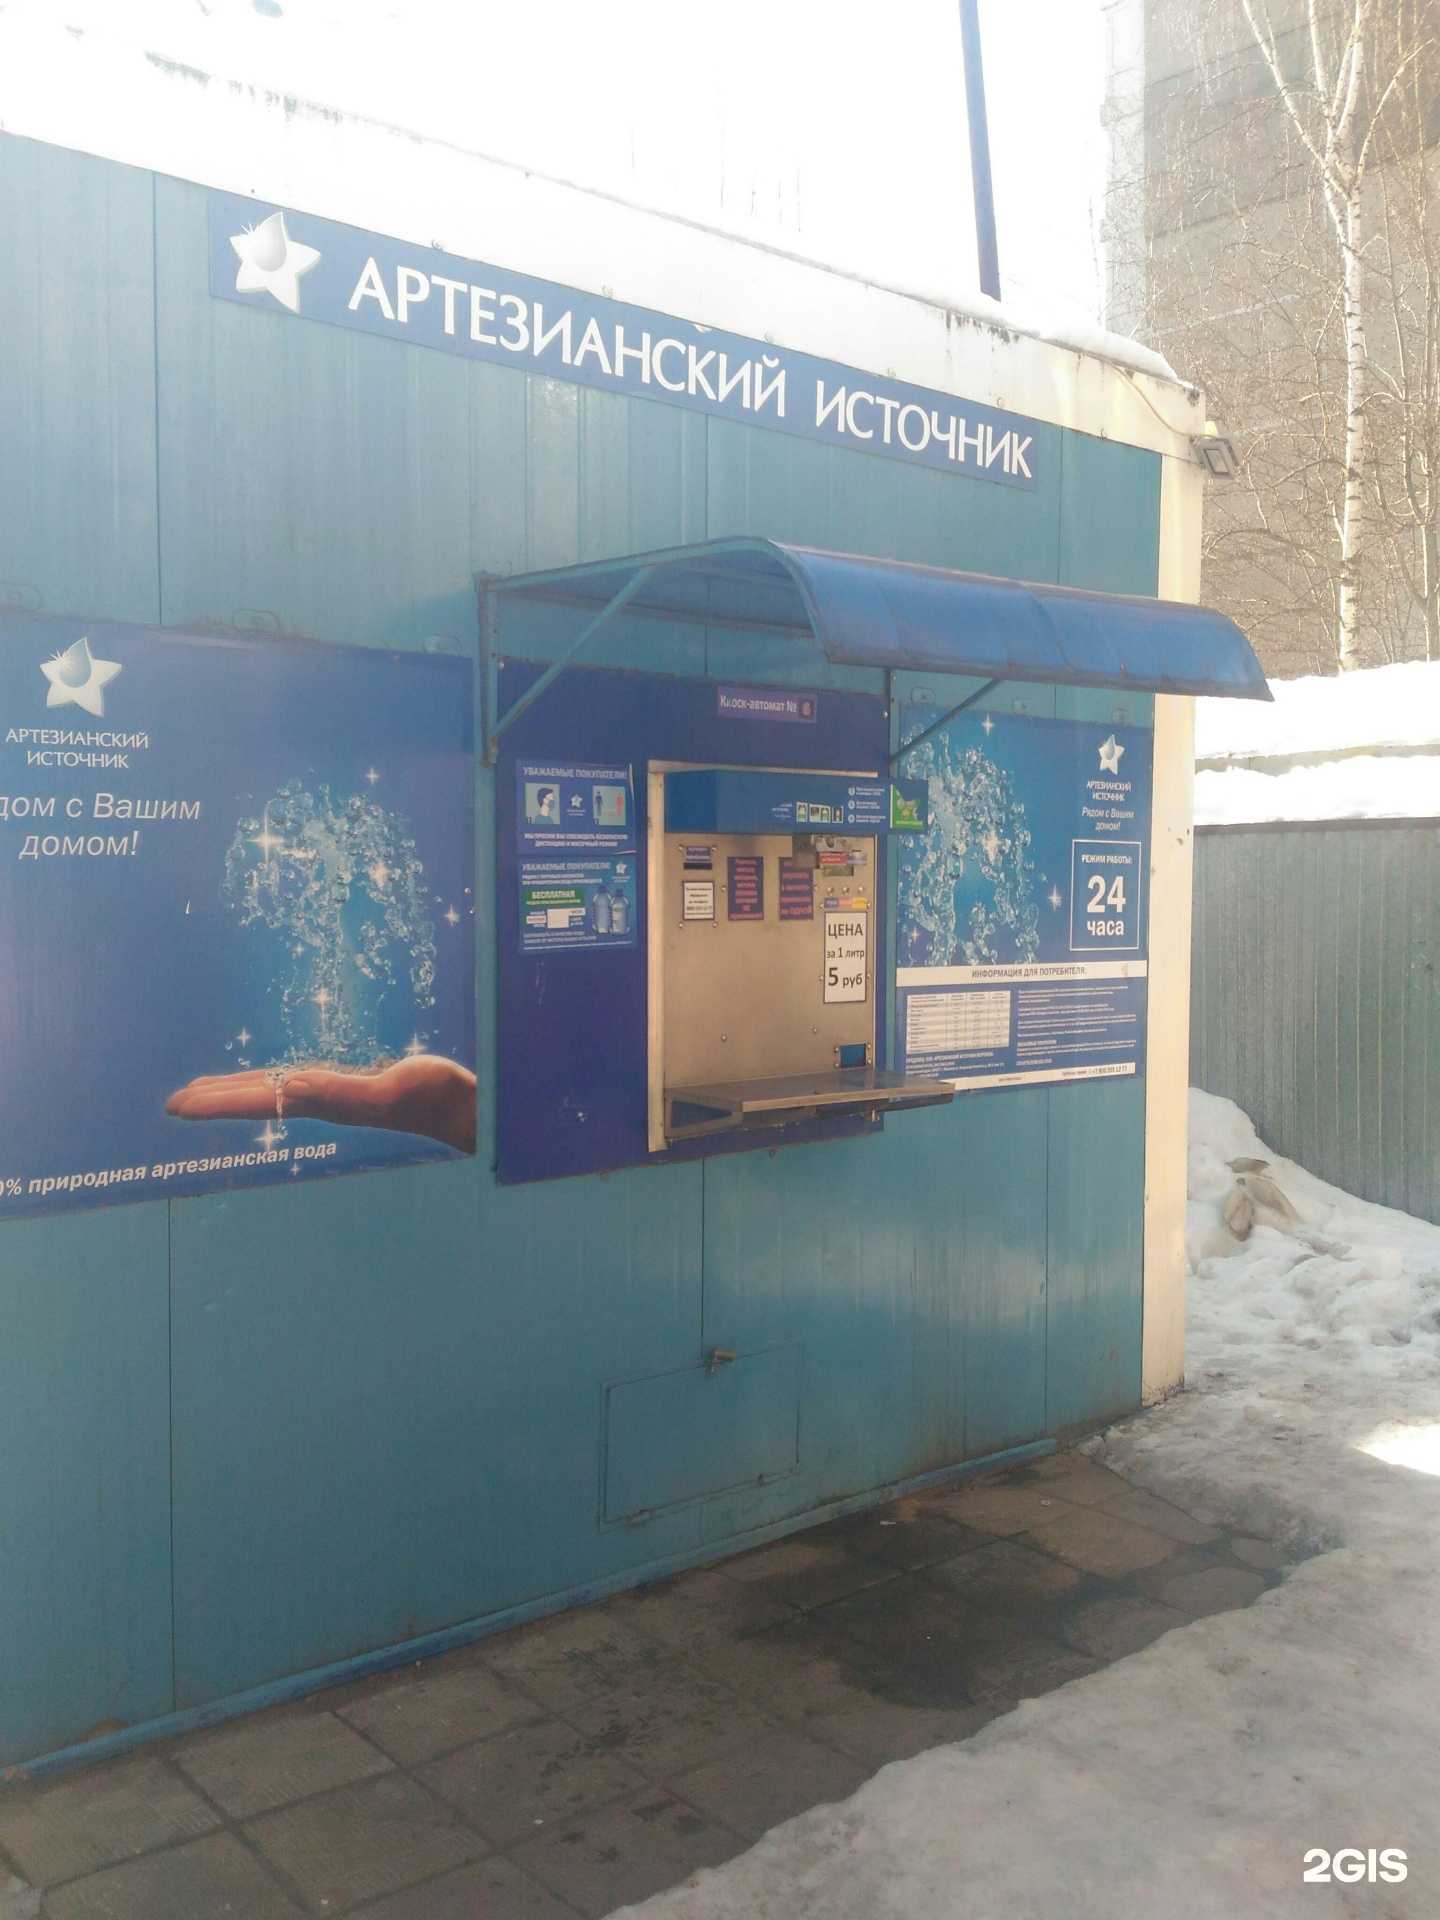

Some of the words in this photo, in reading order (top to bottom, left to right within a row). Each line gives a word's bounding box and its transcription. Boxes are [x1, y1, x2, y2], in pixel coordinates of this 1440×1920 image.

[347, 256, 787, 419] АРТЕЗИАНСКИЙ
[815, 379, 1035, 480] ИСТОЧНИК
[5, 727, 149, 749] АРТЕЗИАНСКИЙ
[26, 750, 129, 769] ИСТОЧНИК
[1086, 780, 1132, 792] АРТЕЗИАНСКИЙ
[66, 798, 83, 818] с
[93, 792, 201, 820] Вашим
[1092, 792, 1126, 802] ИСТОЧНИК
[18, 830, 140, 858] домом!
[1086, 875, 1127, 913] 24
[827, 923, 864, 939] ЦЕНА
[1086, 919, 1126, 936] часа
[826, 950, 836, 959] за
[837, 947, 844, 958] 1
[845, 949, 865, 960] литр
[827, 967, 839, 986] 5
[842, 974, 863, 988] руб
[971, 967, 1022, 978] ИНФОРМАЦИЯ
[1023, 967, 1039, 977] ДЛЯ
[28, 1166, 146, 1195] природная
[151, 1148, 289, 1182] артезианская
[294, 1141, 337, 1160] вода
